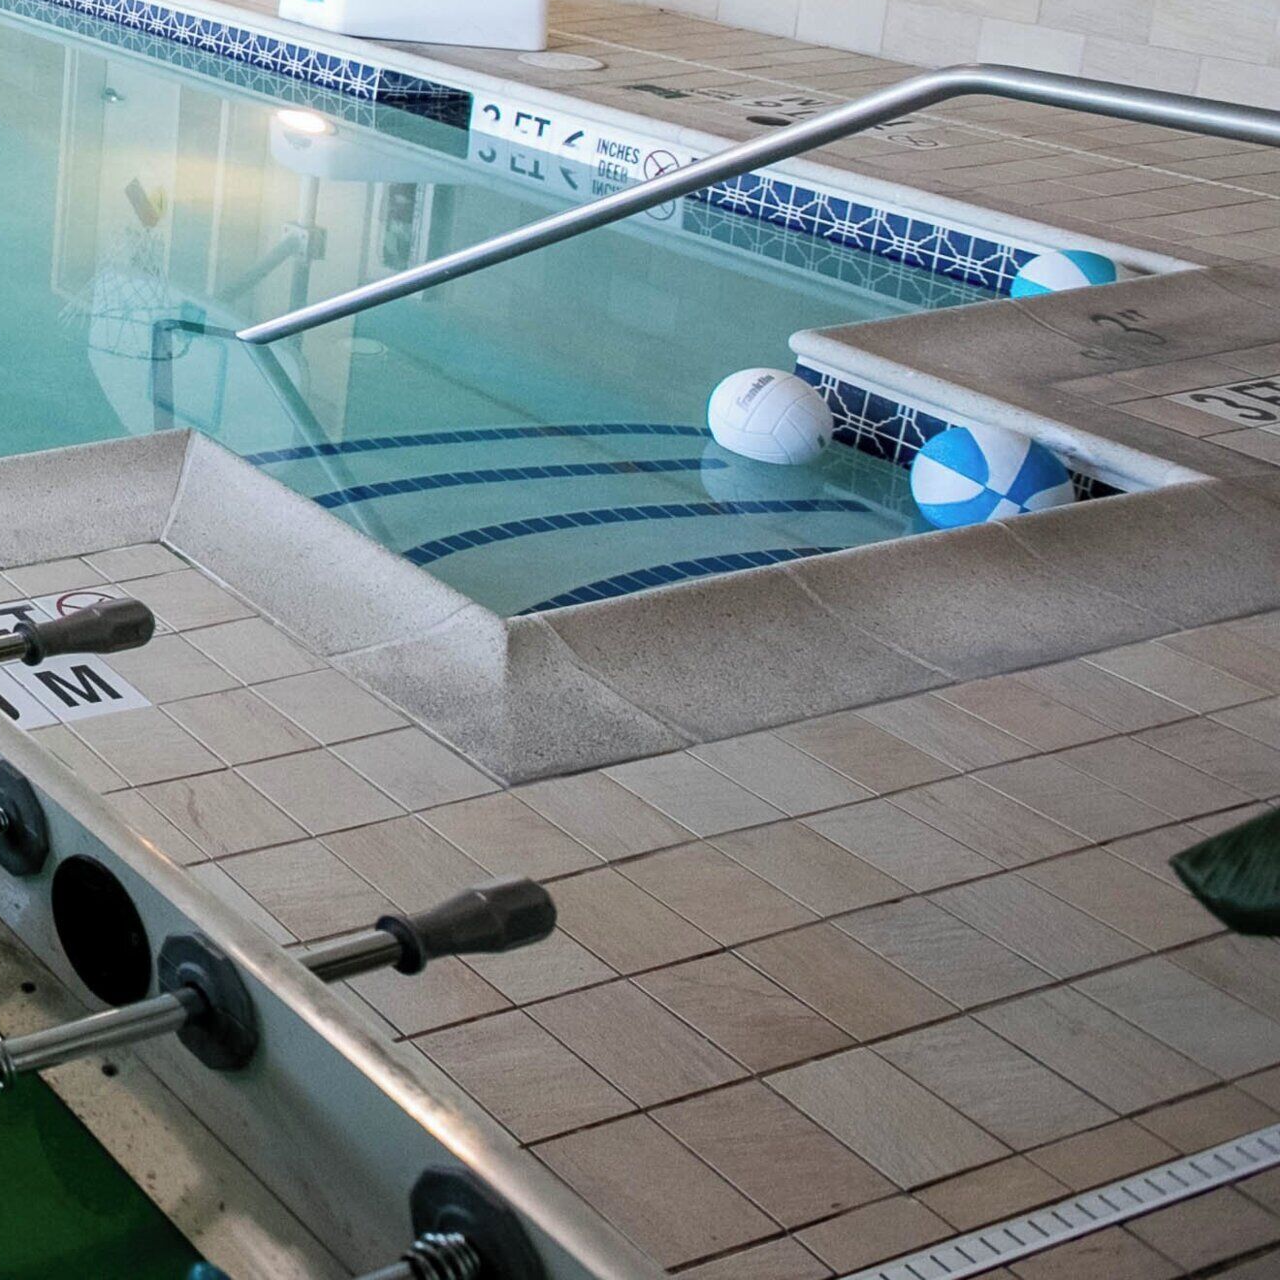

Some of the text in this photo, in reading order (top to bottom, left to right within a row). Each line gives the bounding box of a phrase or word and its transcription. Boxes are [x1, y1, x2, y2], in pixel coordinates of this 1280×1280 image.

[596, 137, 640, 164] INCHES
[736, 375, 775, 412] Franklin
[1190, 394, 1277, 421] 3
[33, 664, 124, 709] M
